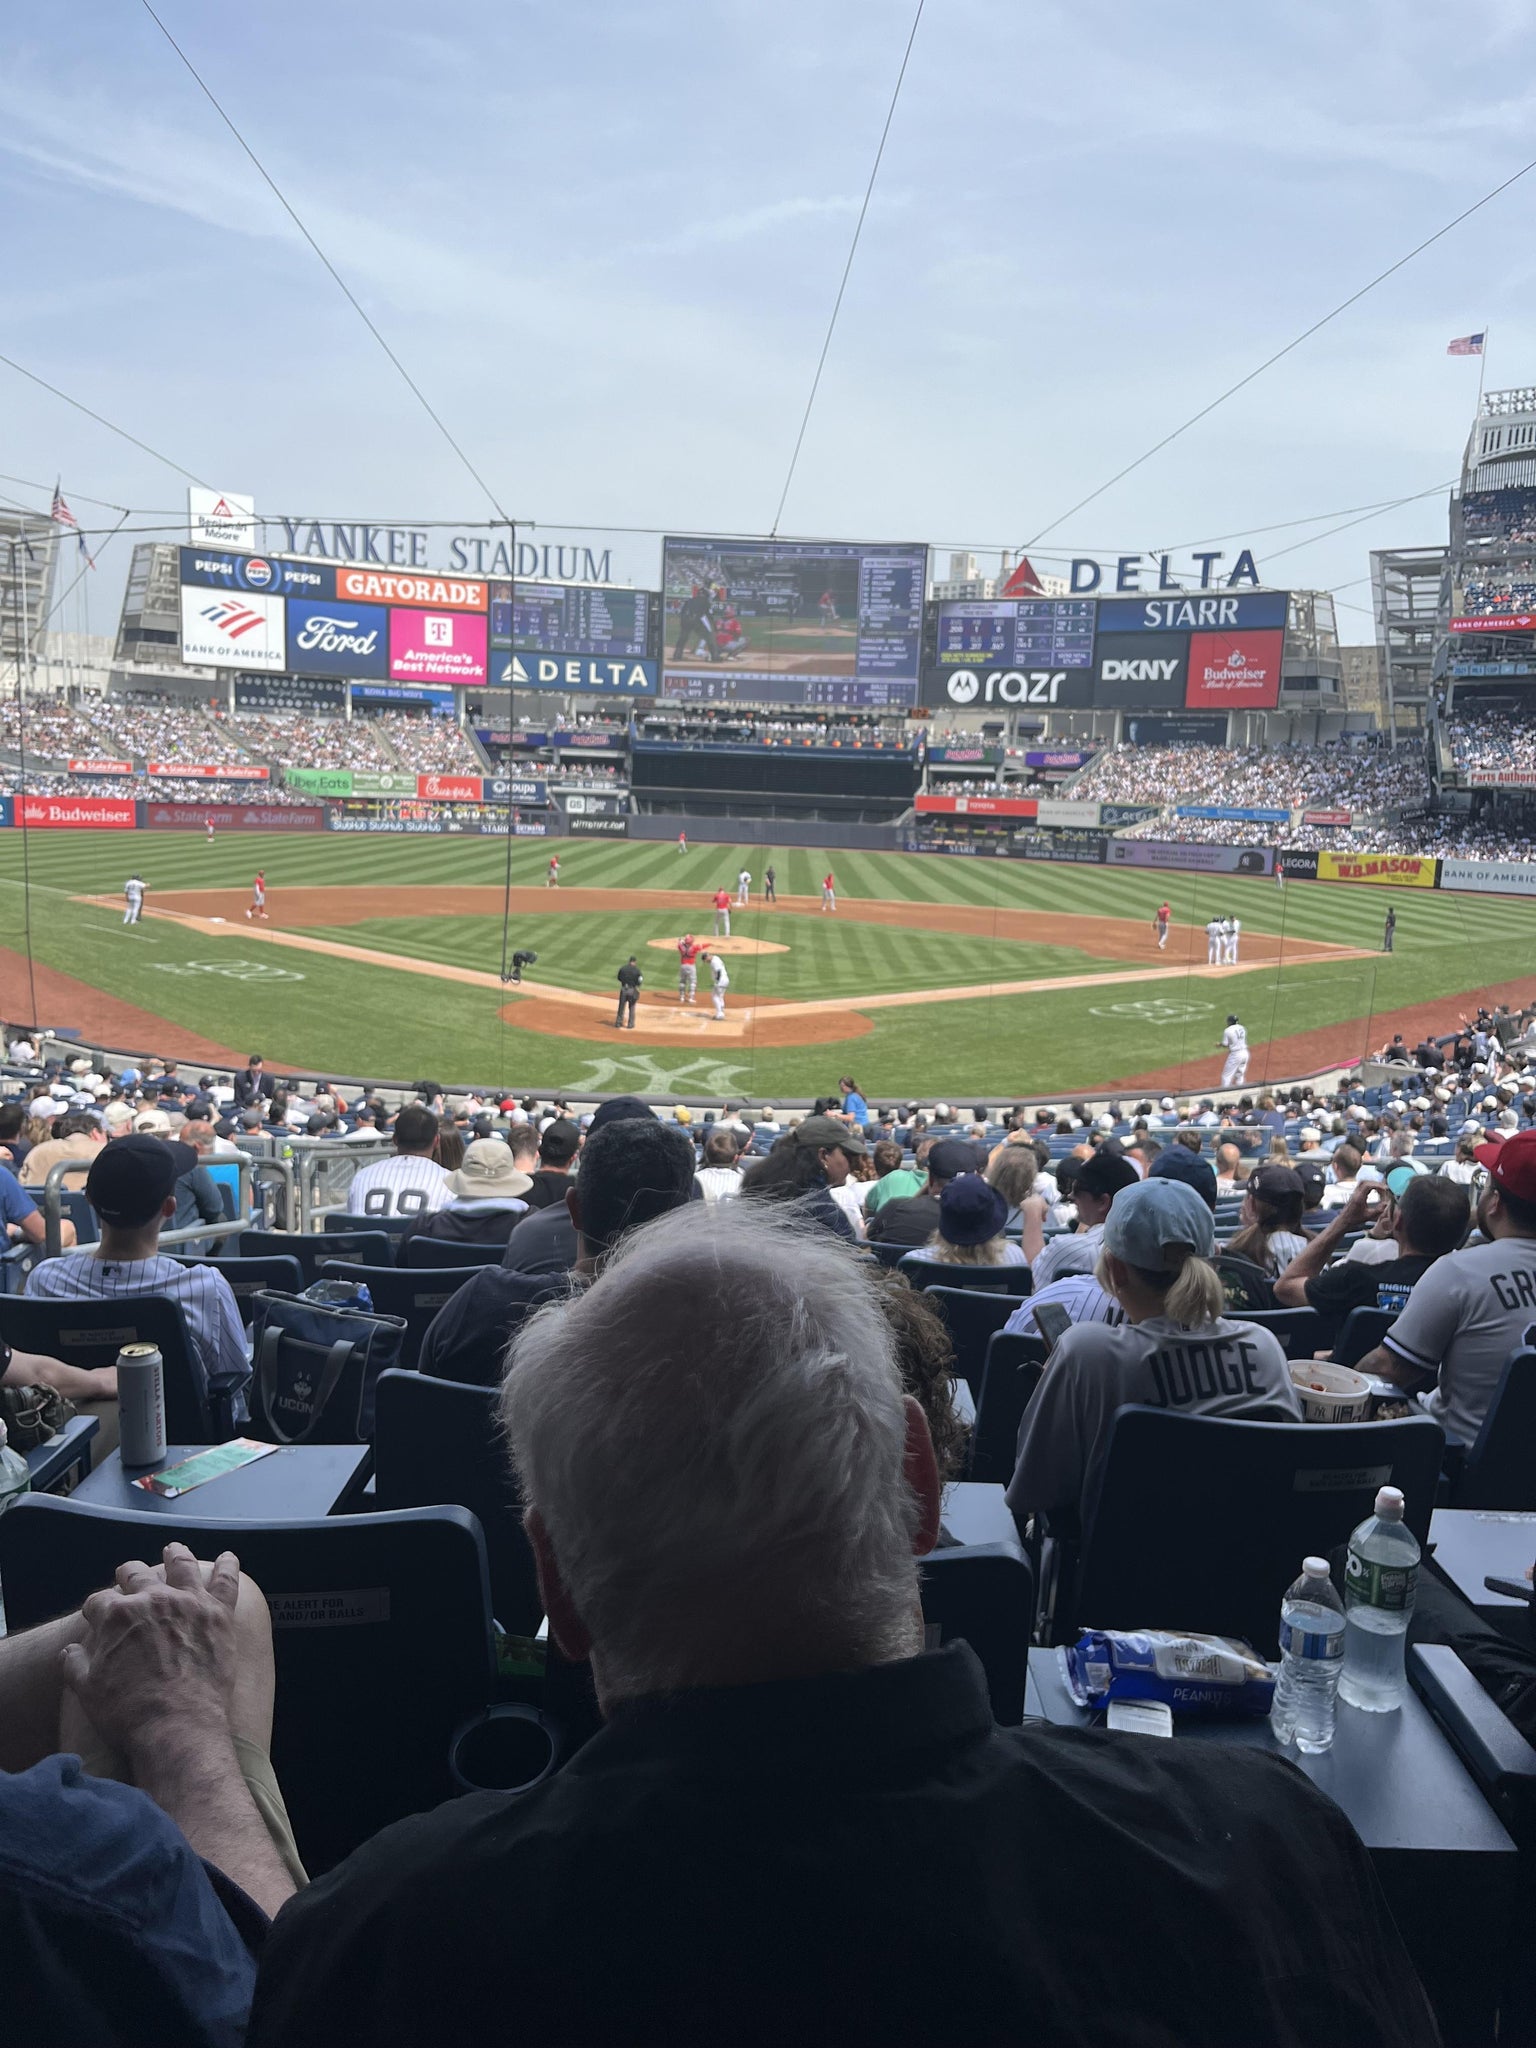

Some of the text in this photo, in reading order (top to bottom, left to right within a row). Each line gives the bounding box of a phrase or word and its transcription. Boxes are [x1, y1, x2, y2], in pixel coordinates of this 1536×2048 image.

[205, 528, 240, 542] Moore
[280, 515, 613, 583] YANKEE STADIUM
[195, 560, 234, 575] PEPSI
[1070, 550, 1261, 594] DELTA
[284, 571, 322, 586] PEPSI
[345, 574, 481, 606] GATORADE
[1144, 598, 1240, 628] STARR
[1483, 619, 1515, 627] AMERICA
[297, 616, 378, 656] Ford
[184, 644, 283, 661] BANK OF AMERICA
[404, 649, 473, 665] America's
[393, 658, 484, 677] Best Network
[538, 658, 649, 688] DELTA
[1101, 659, 1180, 682] DKNY
[1203, 667, 1266, 681] Budweiser
[985, 672, 1068, 704] razr
[288, 773, 318, 788] Uber
[320, 776, 350, 789] Eats
[50, 806, 131, 824] Budweiser
[332, 821, 367, 831] StubHub
[369, 821, 404, 832] StubHub
[406, 821, 442, 833] StubHub
[1281, 857, 1317, 870] LEGORA
[1444, 869, 1474, 881] BANK
[1476, 872, 1490, 882] OF
[364, 1188, 430, 1216] 99
[1489, 1269, 1536, 1311] GR
[1146, 1341, 1267, 1408] JUDGE
[153, 1366, 163, 1448] STELLA ARTOIS
[279, 1396, 315, 1415] UCON
[283, 1599, 318, 1611] ALERT
[322, 1598, 344, 1609] FOR
[278, 1607, 364, 1621] AND/OR BALLS
[1173, 1686, 1232, 1705] PEANUTS
